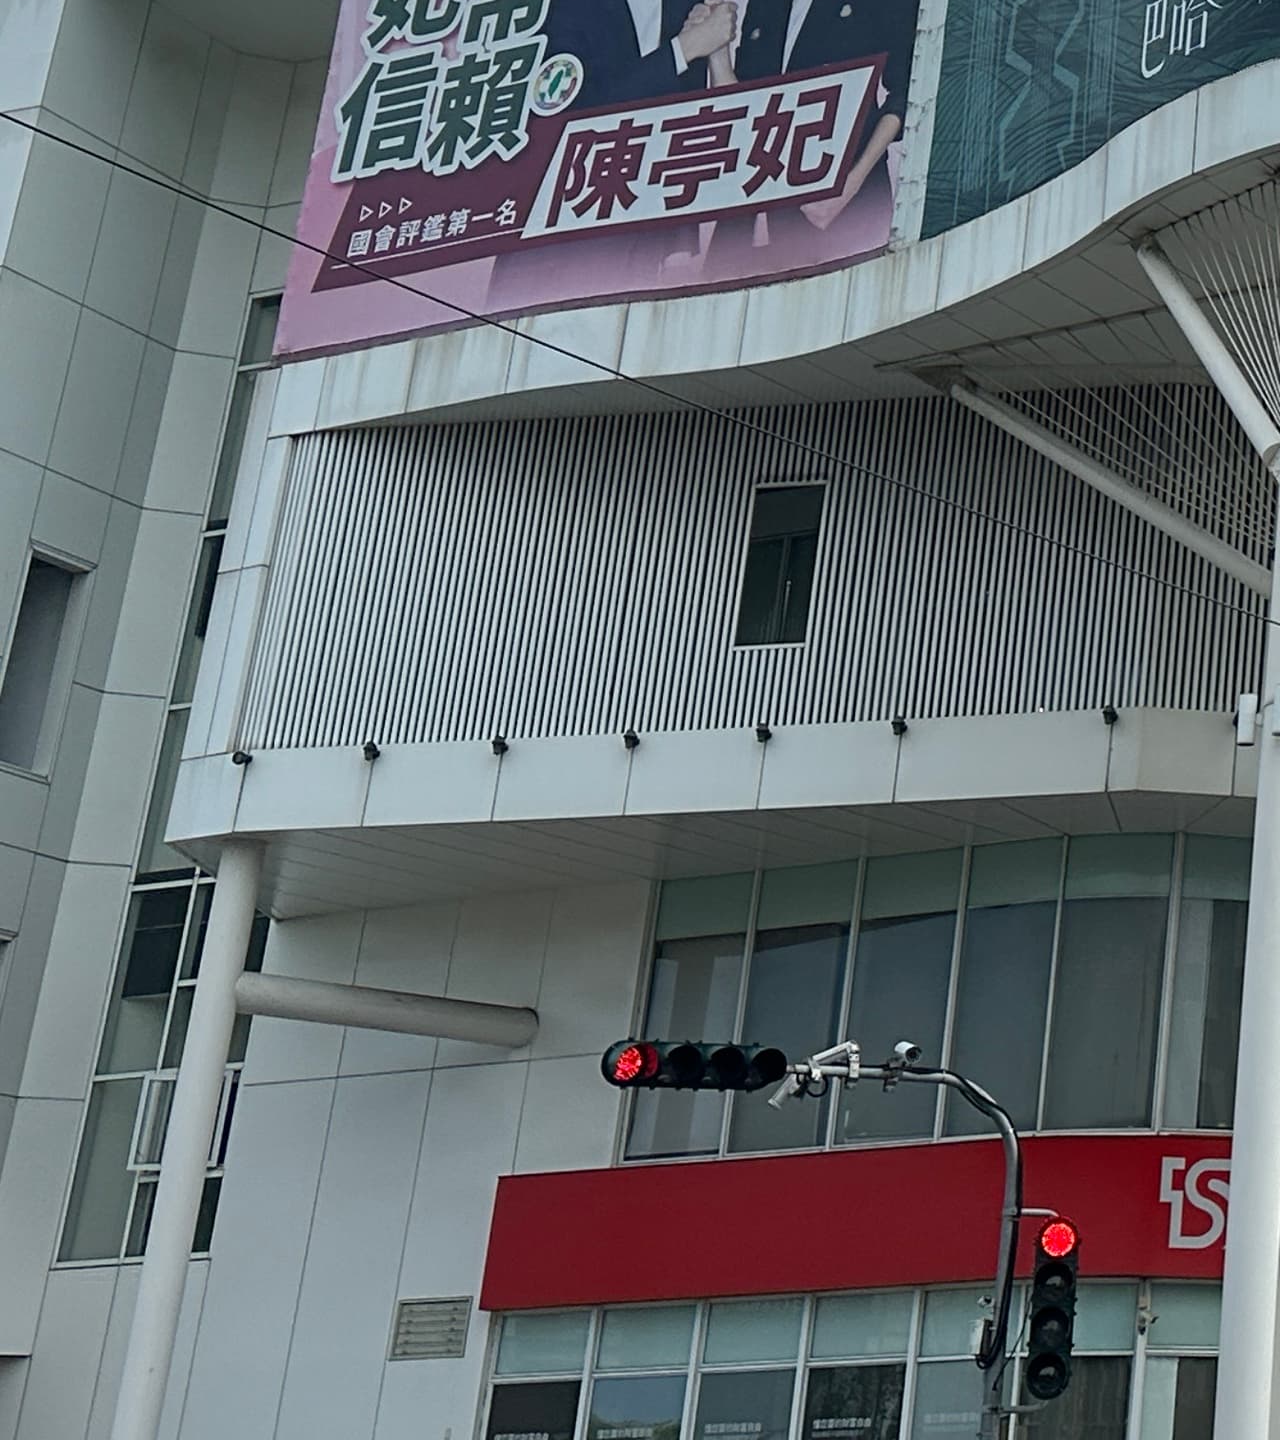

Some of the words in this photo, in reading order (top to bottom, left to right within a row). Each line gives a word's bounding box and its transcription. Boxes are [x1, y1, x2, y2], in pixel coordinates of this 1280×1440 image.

[337, 46, 541, 174] 信賴
[545, 87, 837, 232] 陳亭妃
[346, 198, 517, 258] 國會評鑑第一名
